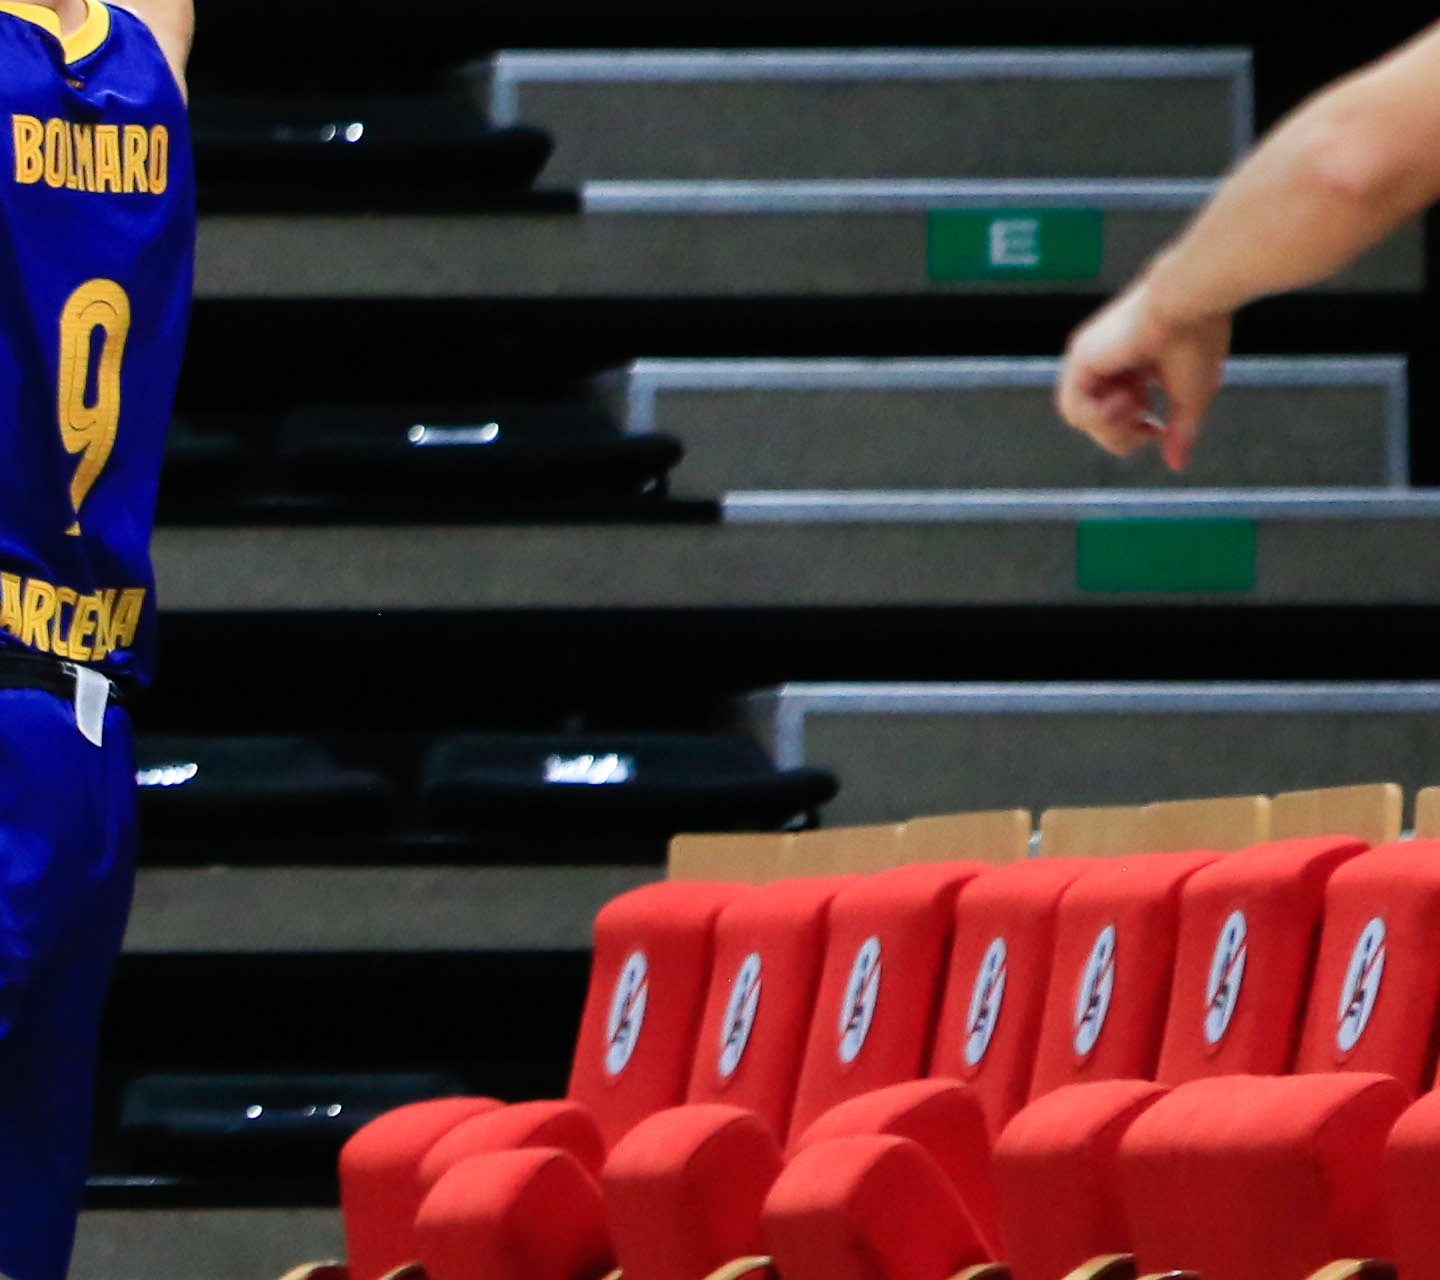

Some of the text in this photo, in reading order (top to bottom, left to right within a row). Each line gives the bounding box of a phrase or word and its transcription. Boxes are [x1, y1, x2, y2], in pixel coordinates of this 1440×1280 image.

[11, 113, 169, 195] BOLMARO
[989, 219, 1041, 265] E
[57, 277, 131, 537] 9
